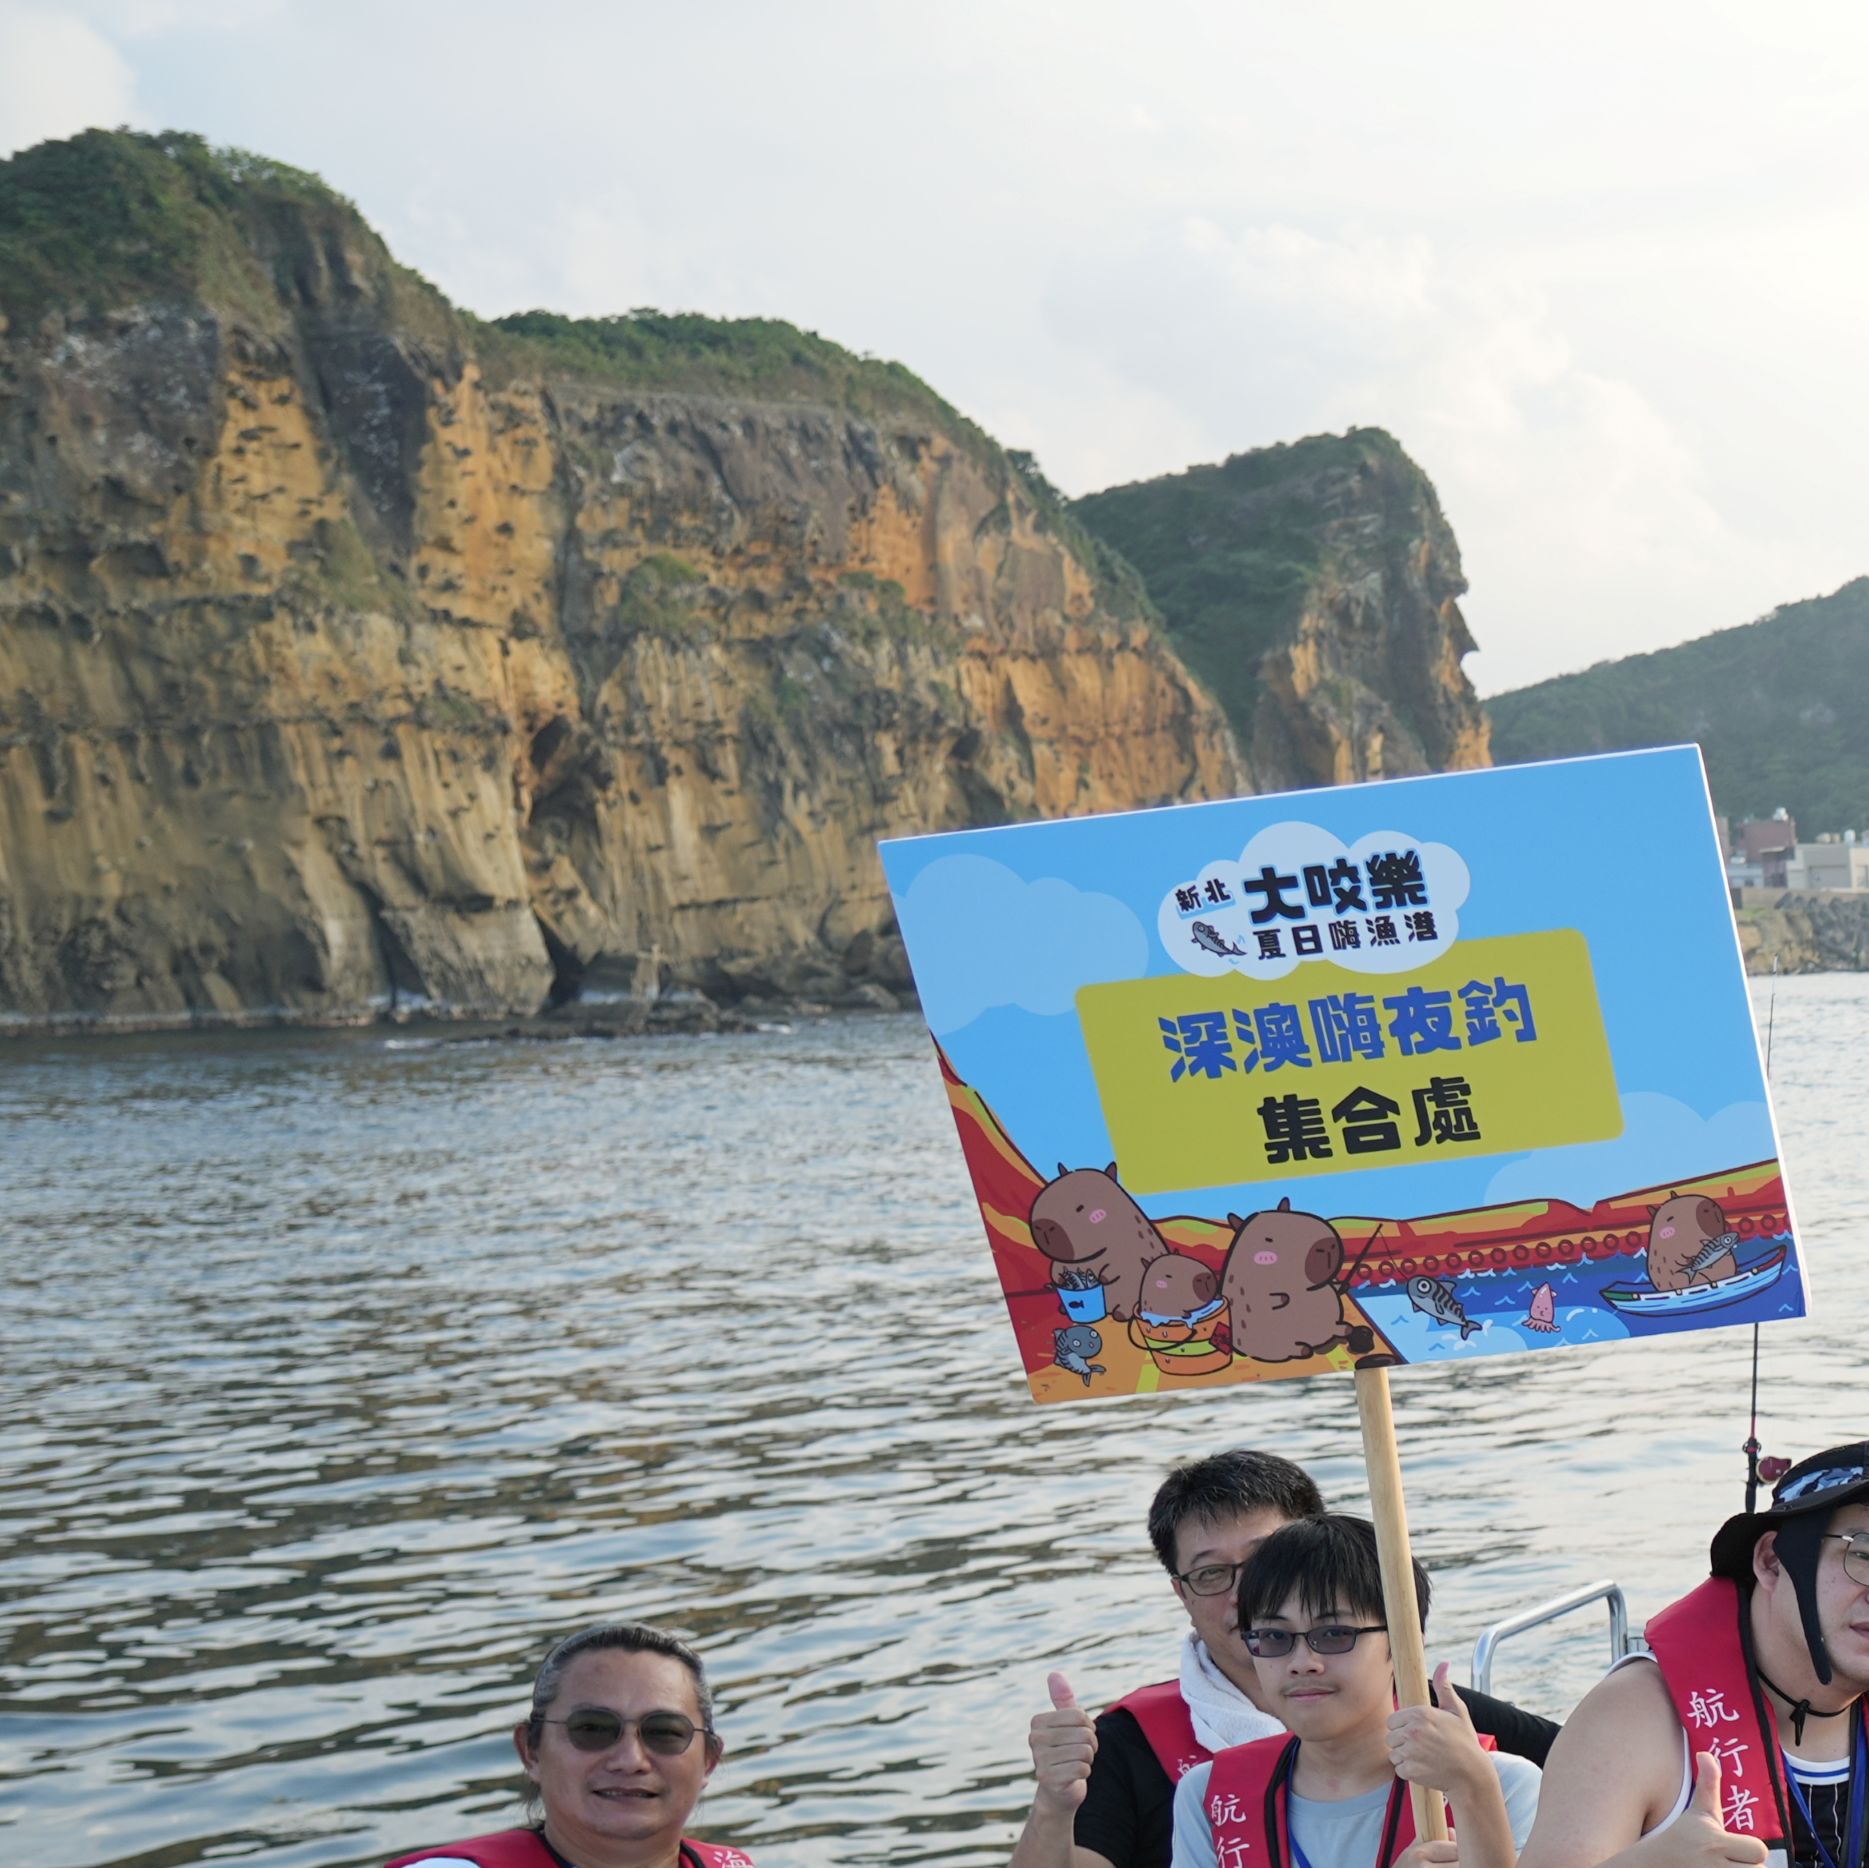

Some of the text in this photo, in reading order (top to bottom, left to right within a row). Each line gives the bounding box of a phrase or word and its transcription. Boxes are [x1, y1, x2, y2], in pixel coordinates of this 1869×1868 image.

[1174, 849, 1428, 923] 新北 大咬樂
[1158, 976, 1538, 1082] 深澳嗨夜釣
[1257, 1075, 1481, 1164] 集合處
